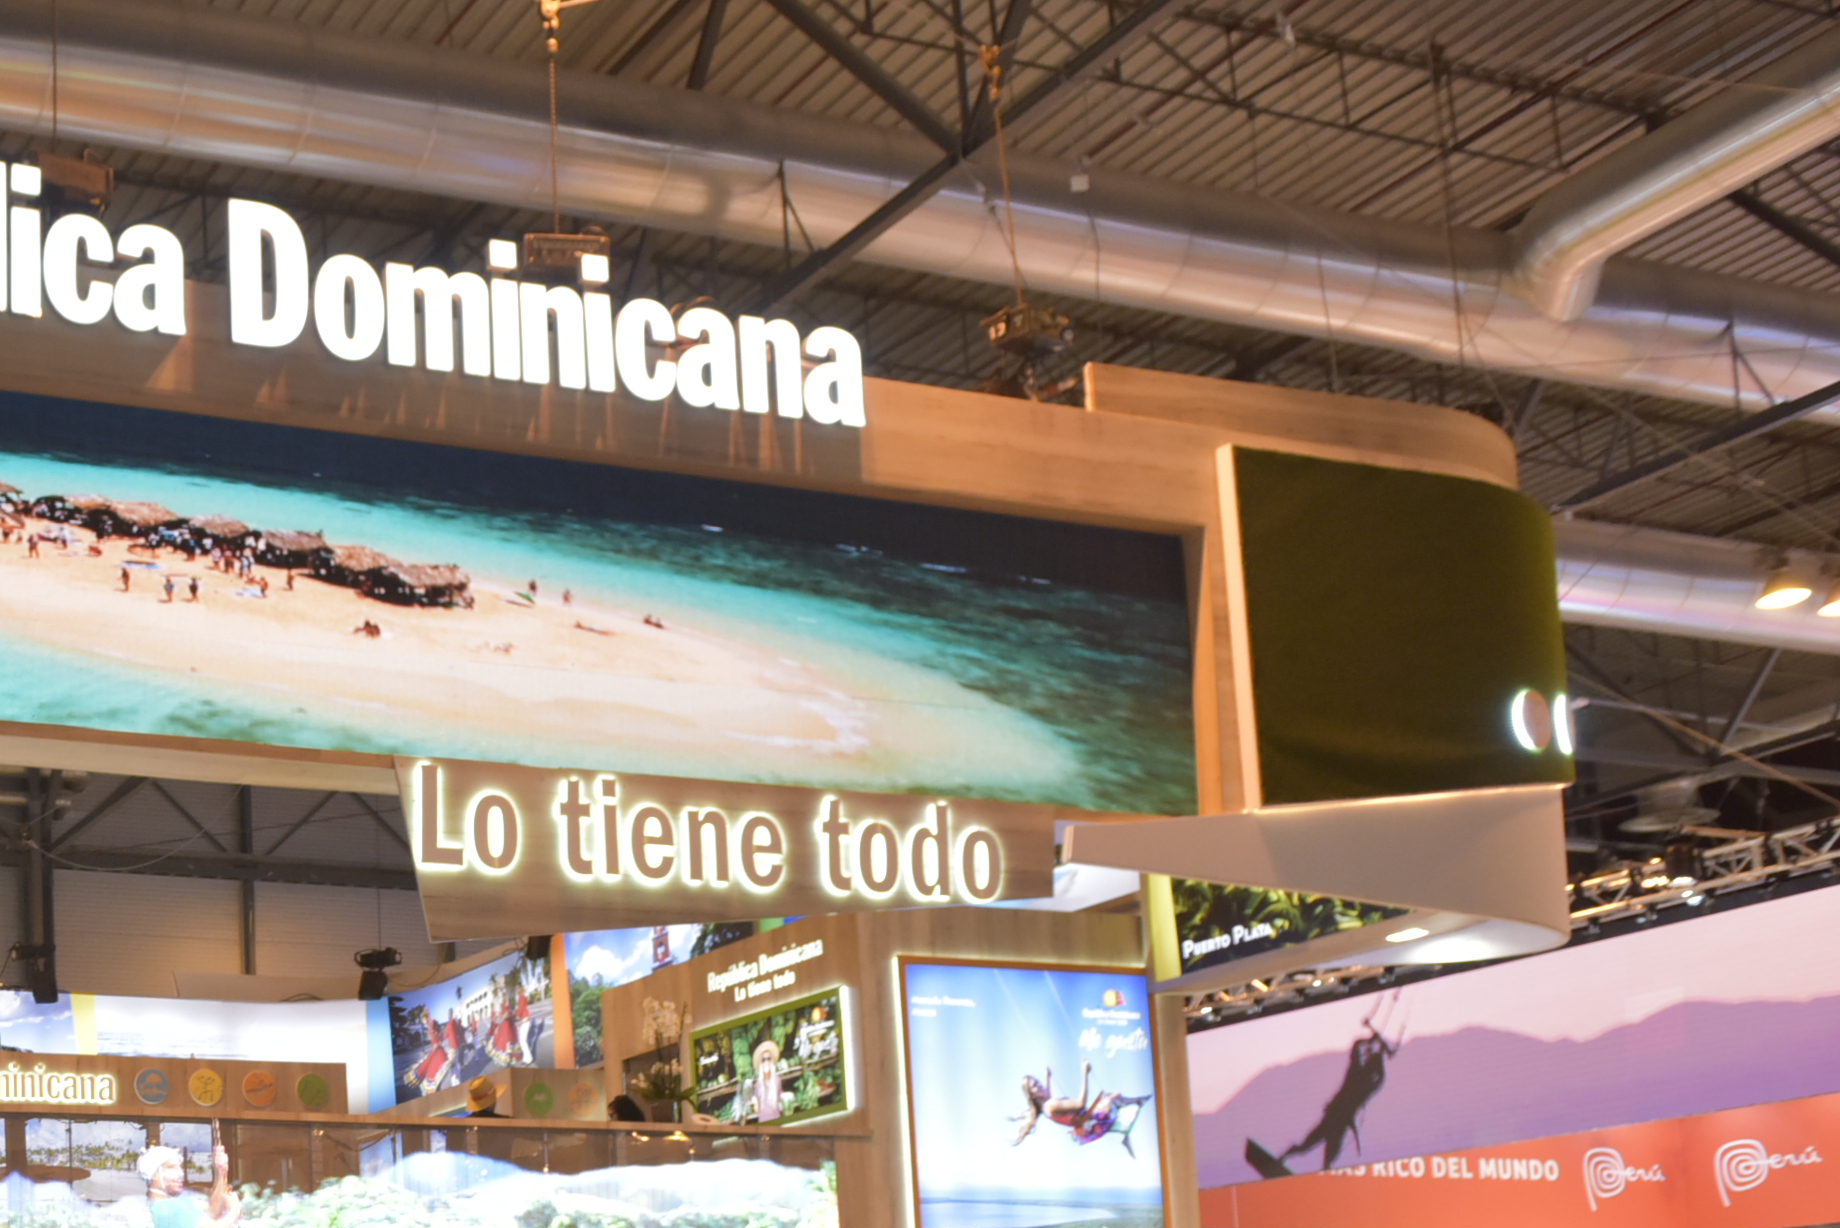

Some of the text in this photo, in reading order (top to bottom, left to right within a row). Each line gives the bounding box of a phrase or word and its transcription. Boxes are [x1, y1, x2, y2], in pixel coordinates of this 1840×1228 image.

[228, 198, 865, 426] Dominicana
[416, 761, 1005, 903] Lo tiene todo
[707, 939, 824, 993] República Dominicana
[734, 970, 796, 1002] Lo tiene todo
[1372, 1156, 1426, 1178] RICO
[1431, 1156, 1474, 1179] DEL
[1479, 1158, 1561, 1182] MUNDO
